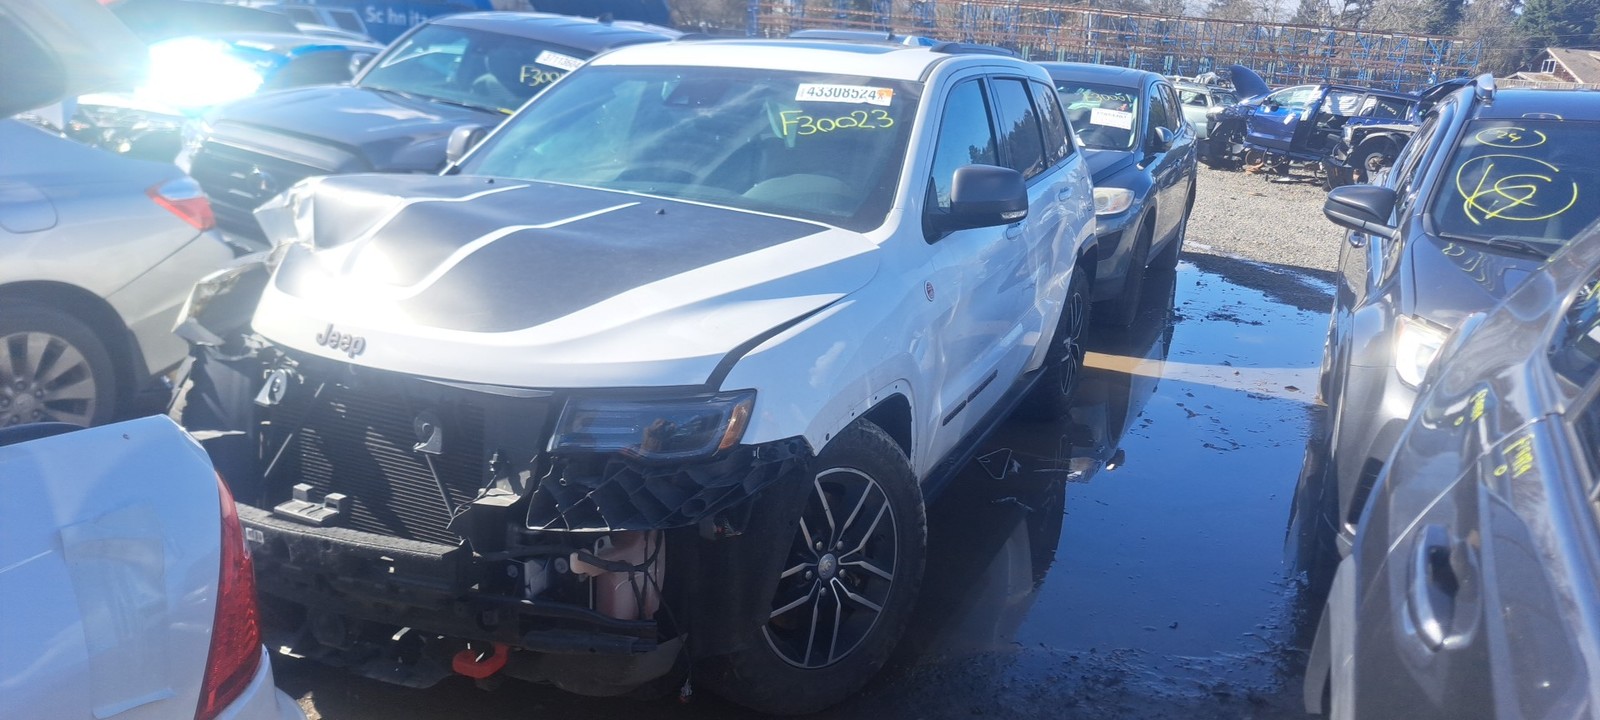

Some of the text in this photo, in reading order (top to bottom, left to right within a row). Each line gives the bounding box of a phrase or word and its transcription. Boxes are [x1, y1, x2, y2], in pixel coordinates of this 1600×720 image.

[520, 65, 564, 87] F300
[806, 87, 877, 100] 43308524
[779, 109, 894, 136] F30023
[316, 323, 366, 359] Jeep
